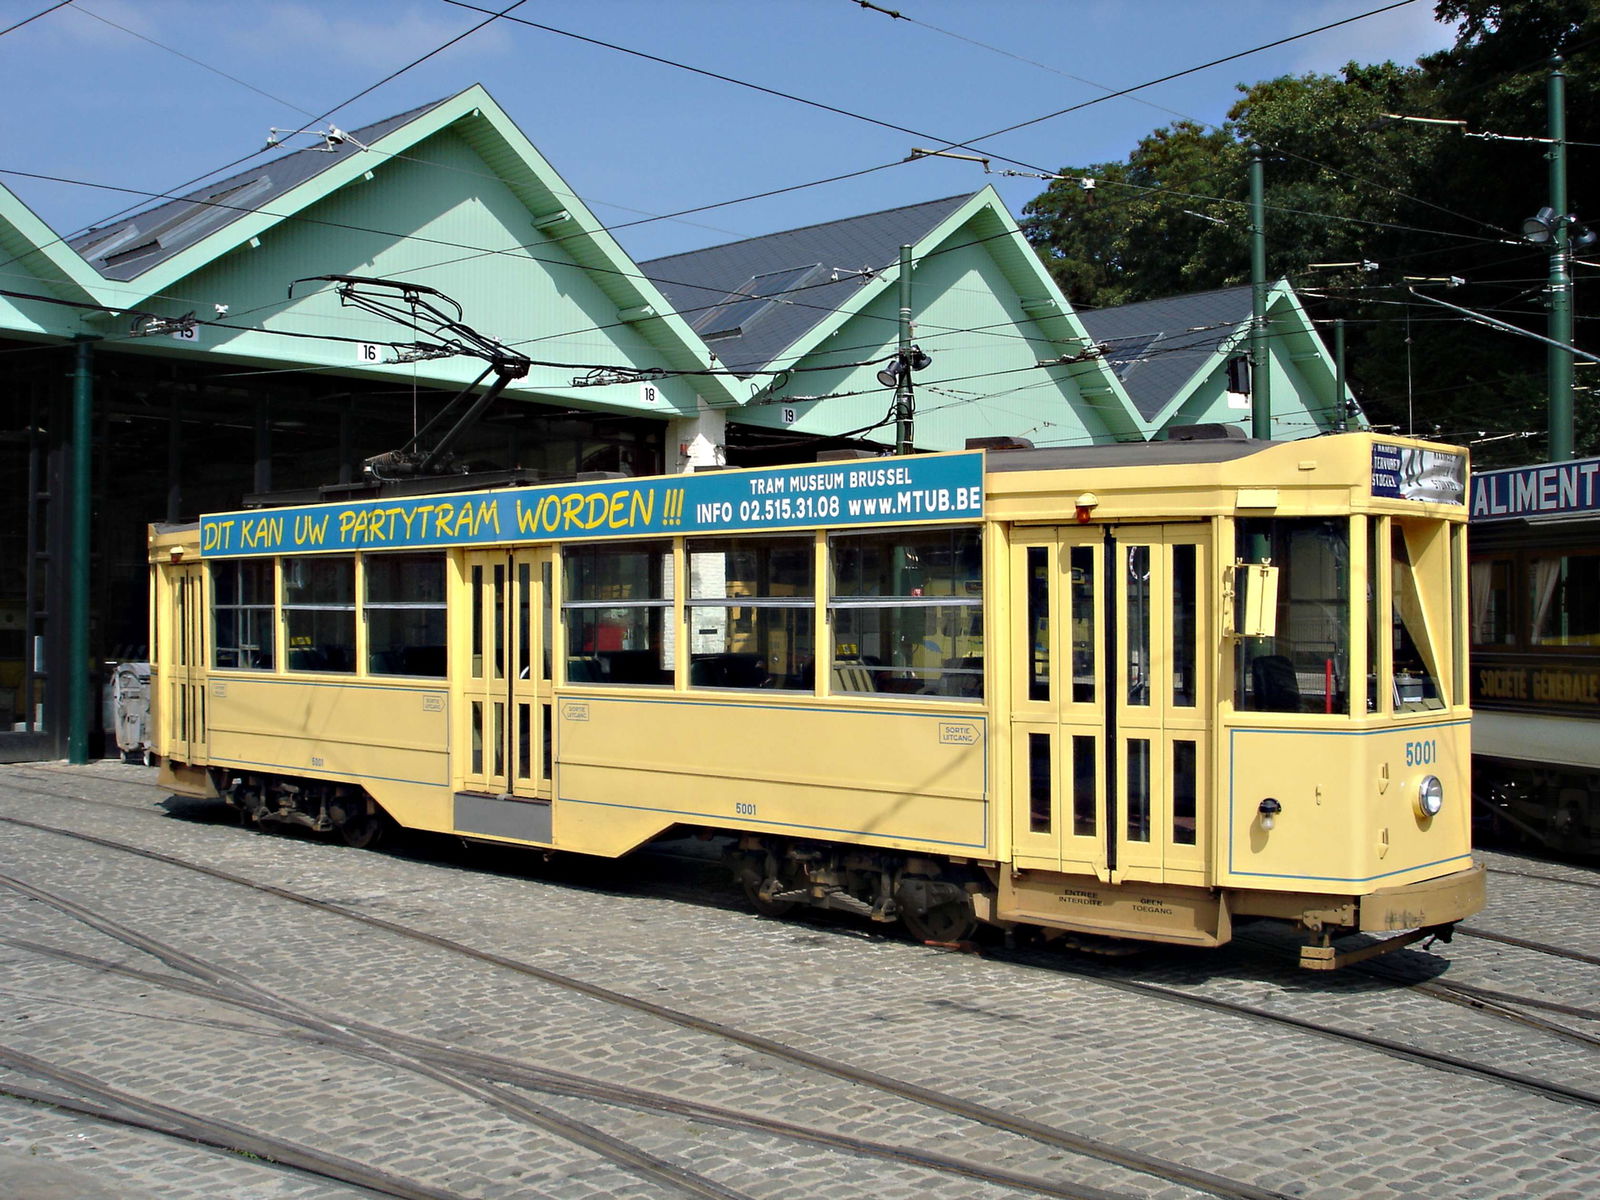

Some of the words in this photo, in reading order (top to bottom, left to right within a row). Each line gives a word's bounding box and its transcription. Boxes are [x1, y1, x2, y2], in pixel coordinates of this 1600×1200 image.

[363, 344, 376, 361] 16
[645, 387, 655, 402] 18
[785, 409, 794, 423] 19
[750, 477, 785, 495] TRAM
[790, 473, 844, 493] MUSEUM
[849, 467, 912, 489] BRUSSEL
[1473, 463, 1599, 517] ALIMENT
[696, 502, 733, 524] INFO
[740, 496, 840, 522] 02.515.31.08
[203, 520, 235, 551] DIT
[240, 517, 284, 549] KAN
[294, 514, 329, 545] UW
[338, 499, 500, 543] PARTYTRAM
[516, 488, 655, 534] WORDEN
[945, 726, 971, 734] SORTIE
[943, 734, 973, 742] UITGANG
[1406, 739, 1436, 767] 5001
[736, 802, 757, 816] 5001
[1059, 896, 1103, 907] INTERDITE
[1140, 898, 1163, 907] GEEN
[1132, 904, 1173, 915] TOEGANG
